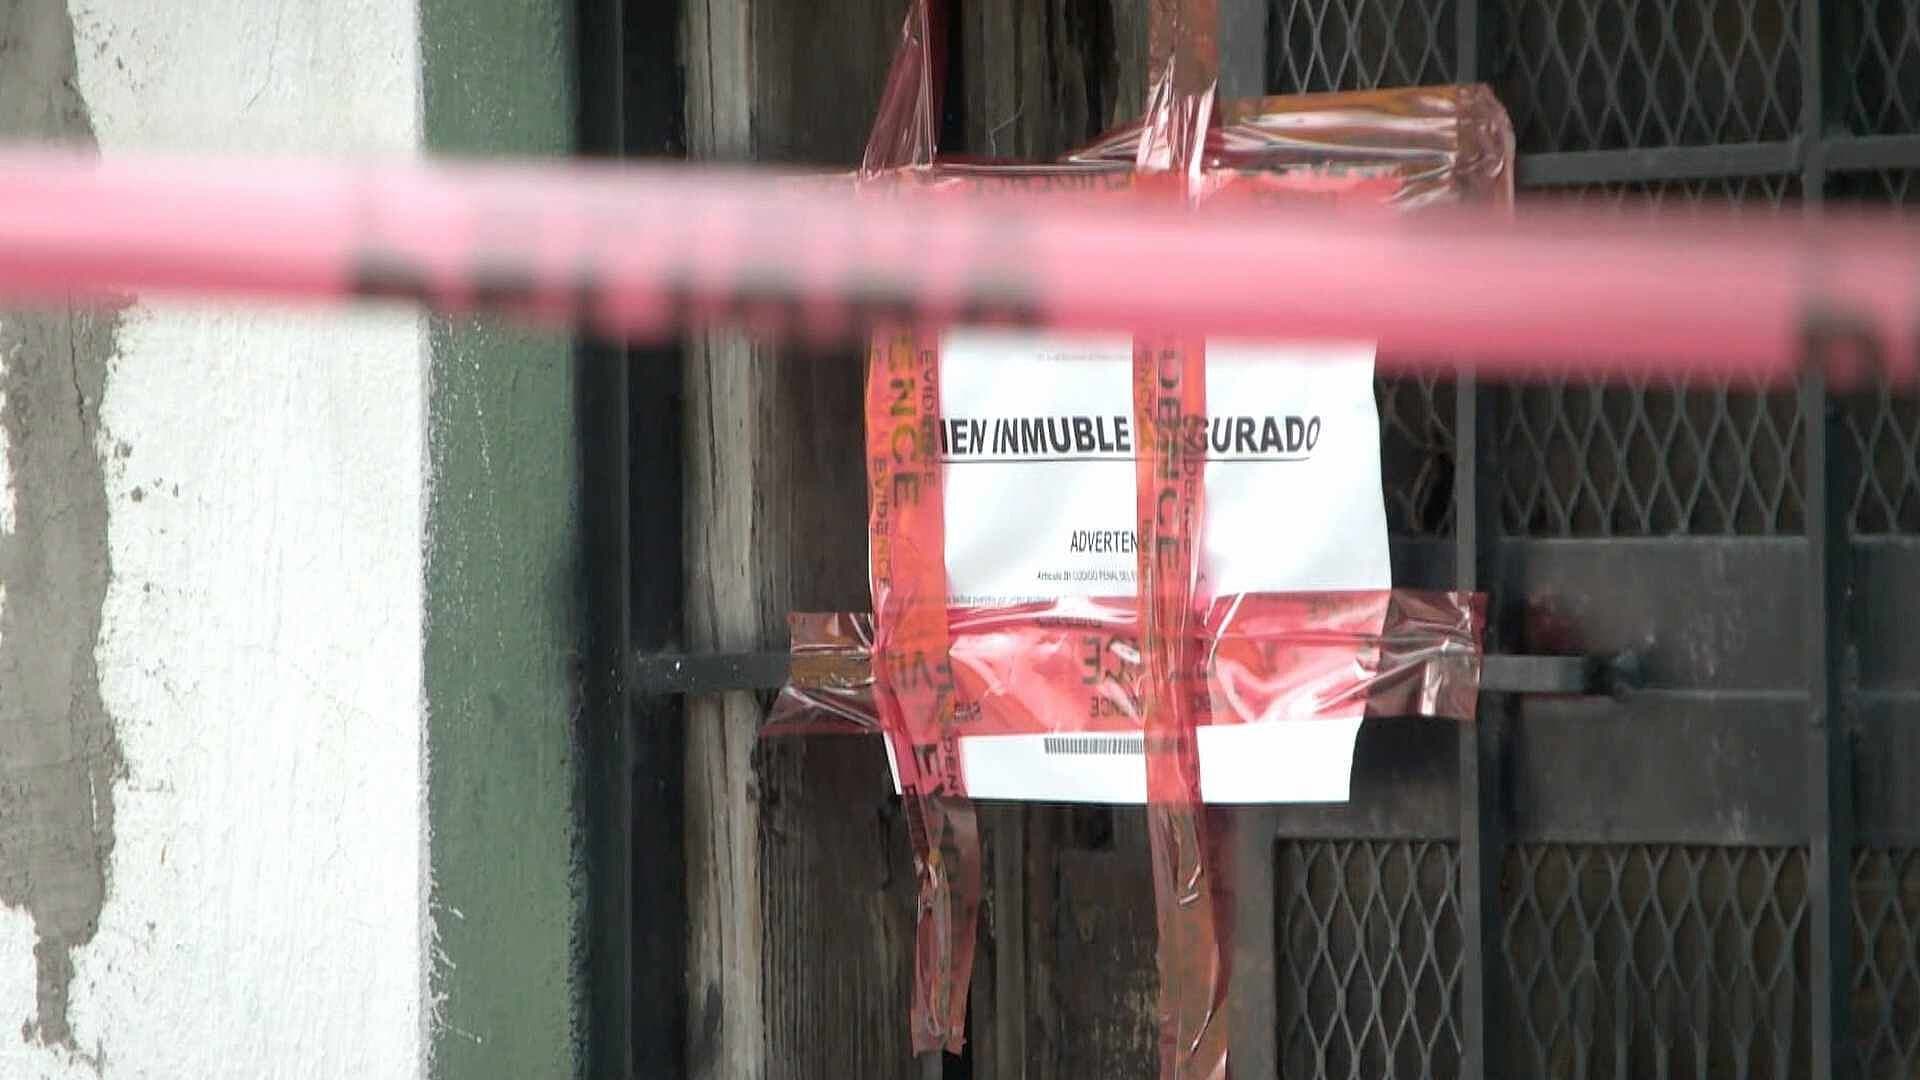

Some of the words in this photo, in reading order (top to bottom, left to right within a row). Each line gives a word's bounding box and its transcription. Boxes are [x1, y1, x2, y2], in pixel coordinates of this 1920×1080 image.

[930, 416, 988, 456] IEN
[991, 415, 1133, 456] INMUBLE
[1178, 414, 1322, 454] GURADO
[1069, 528, 1139, 554] ADVERTEN
